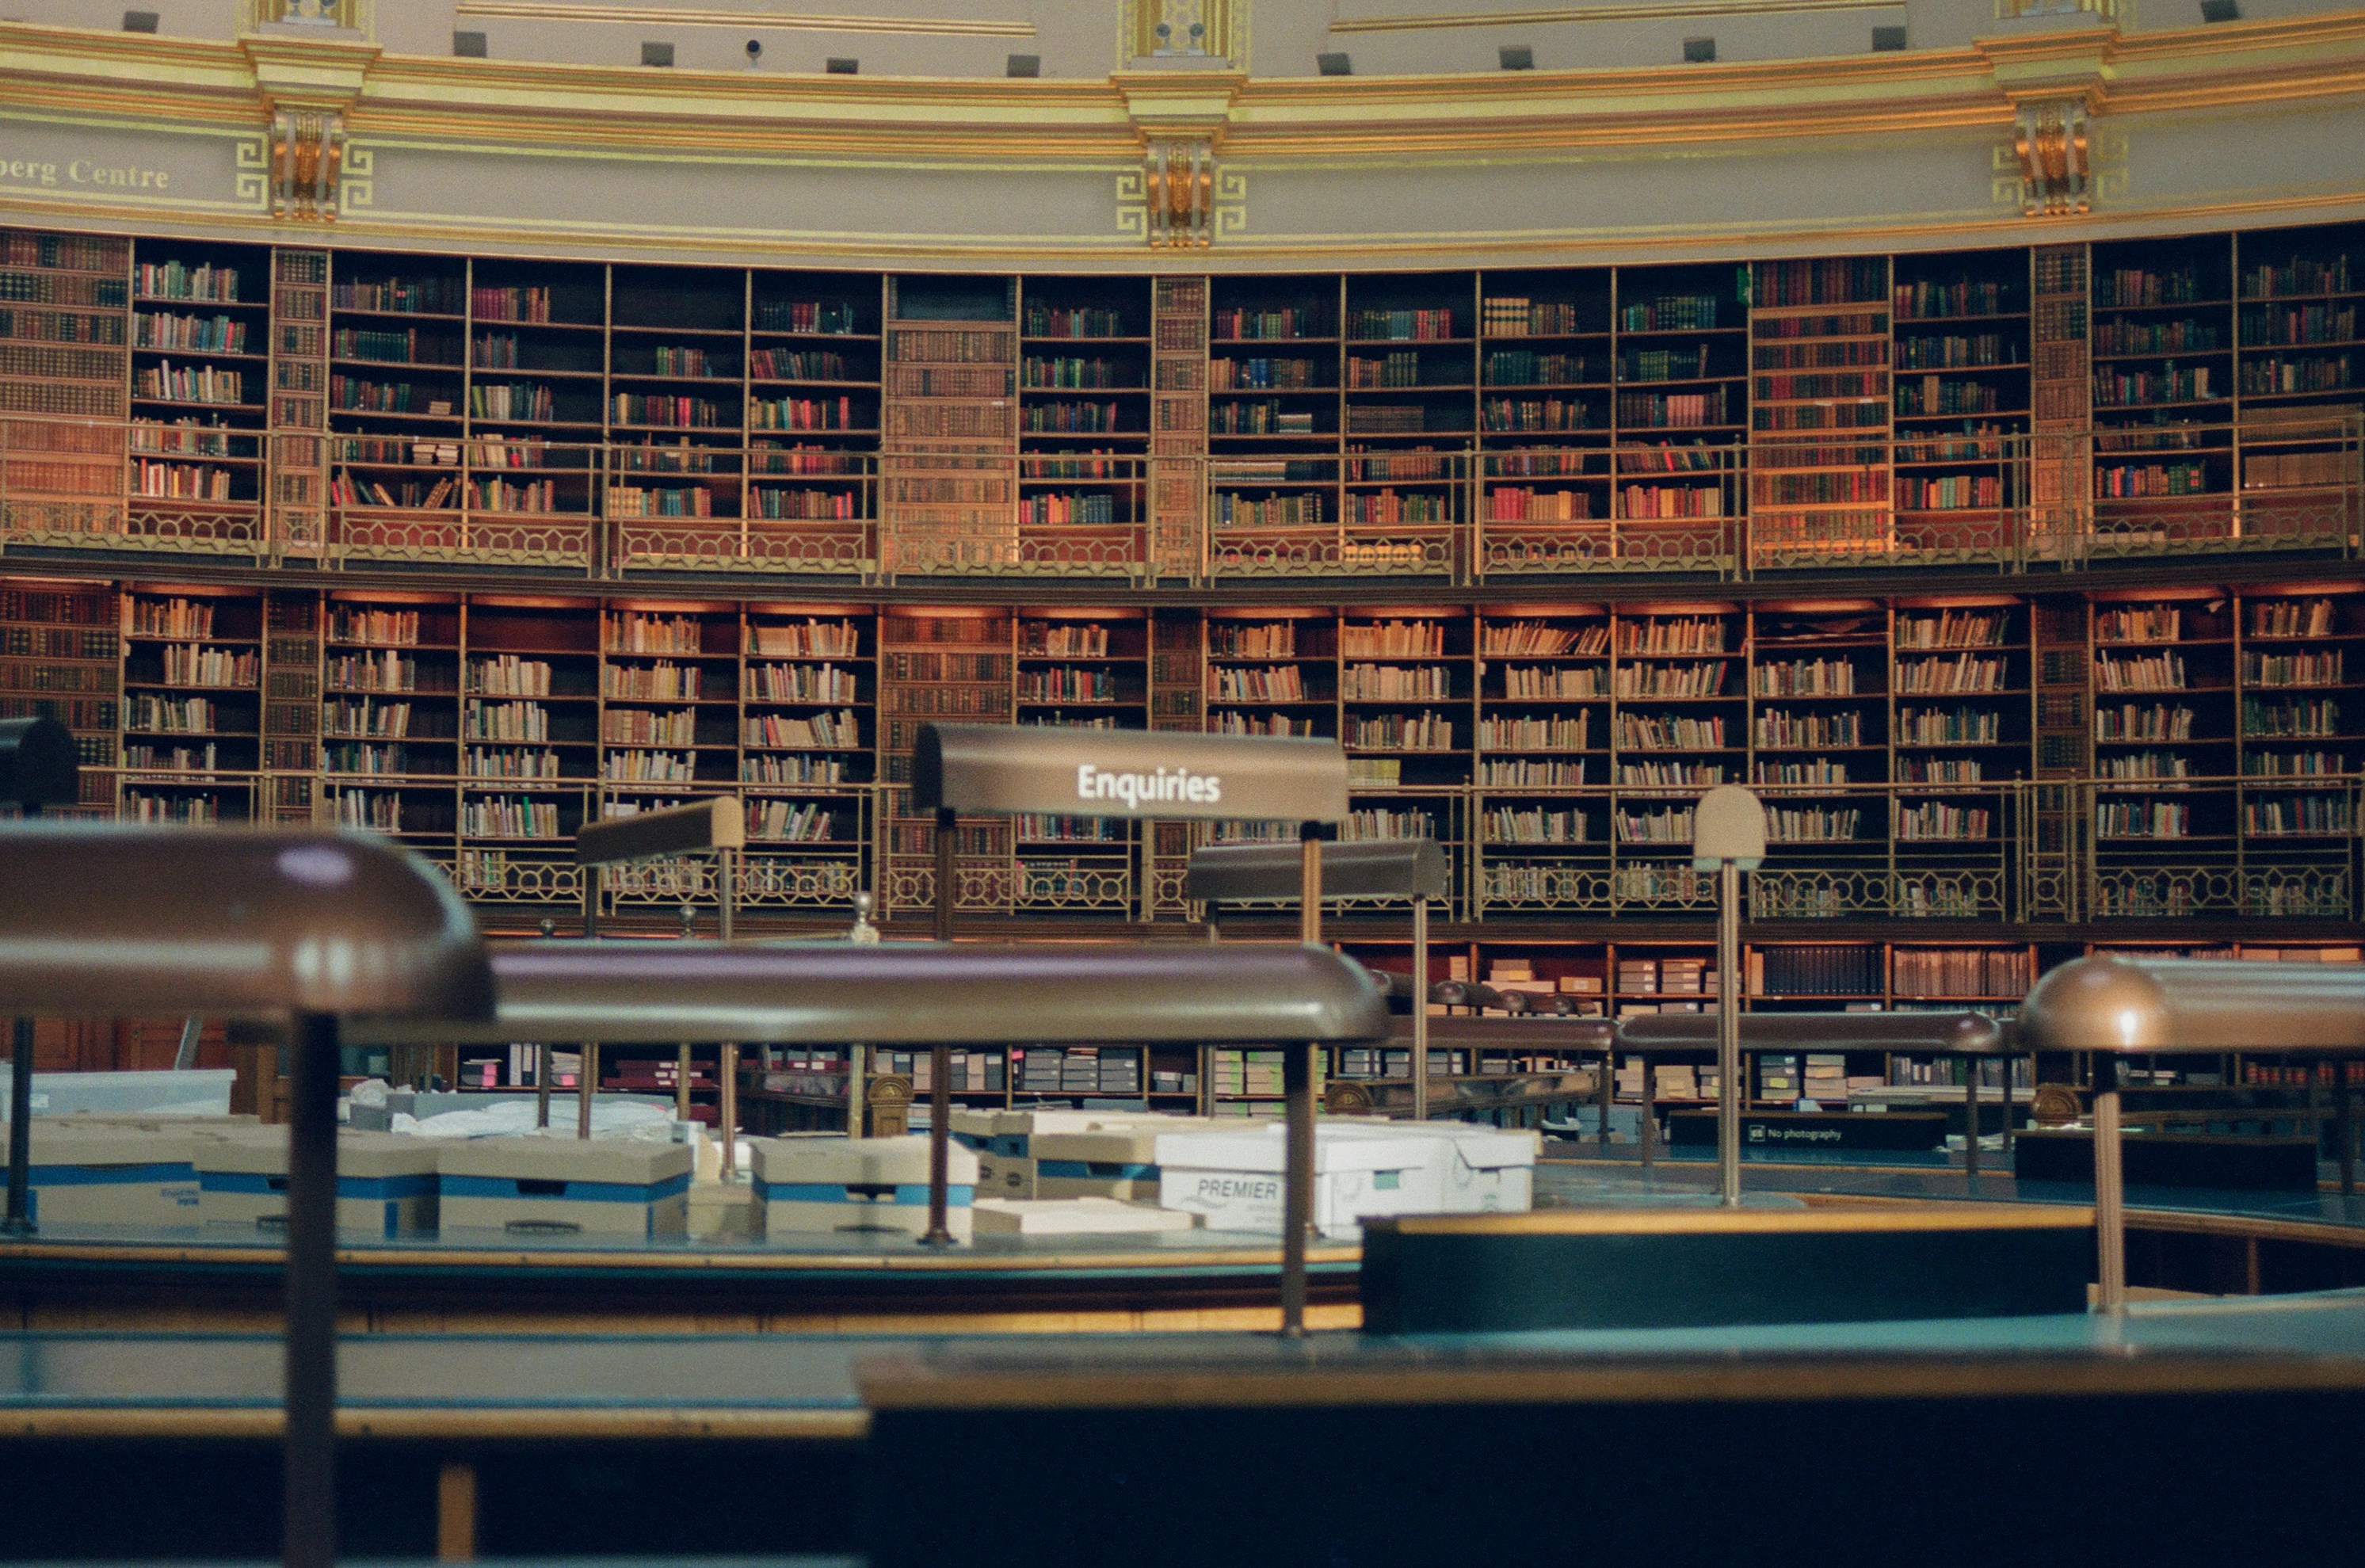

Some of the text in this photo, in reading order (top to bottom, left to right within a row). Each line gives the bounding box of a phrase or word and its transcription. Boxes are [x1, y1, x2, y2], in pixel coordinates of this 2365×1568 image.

[69, 160, 169, 189] Centre
[1078, 764, 1220, 809] Enquiries
[1768, 1128, 1841, 1141] No photography
[1198, 1179, 1277, 1199] PREMIER
